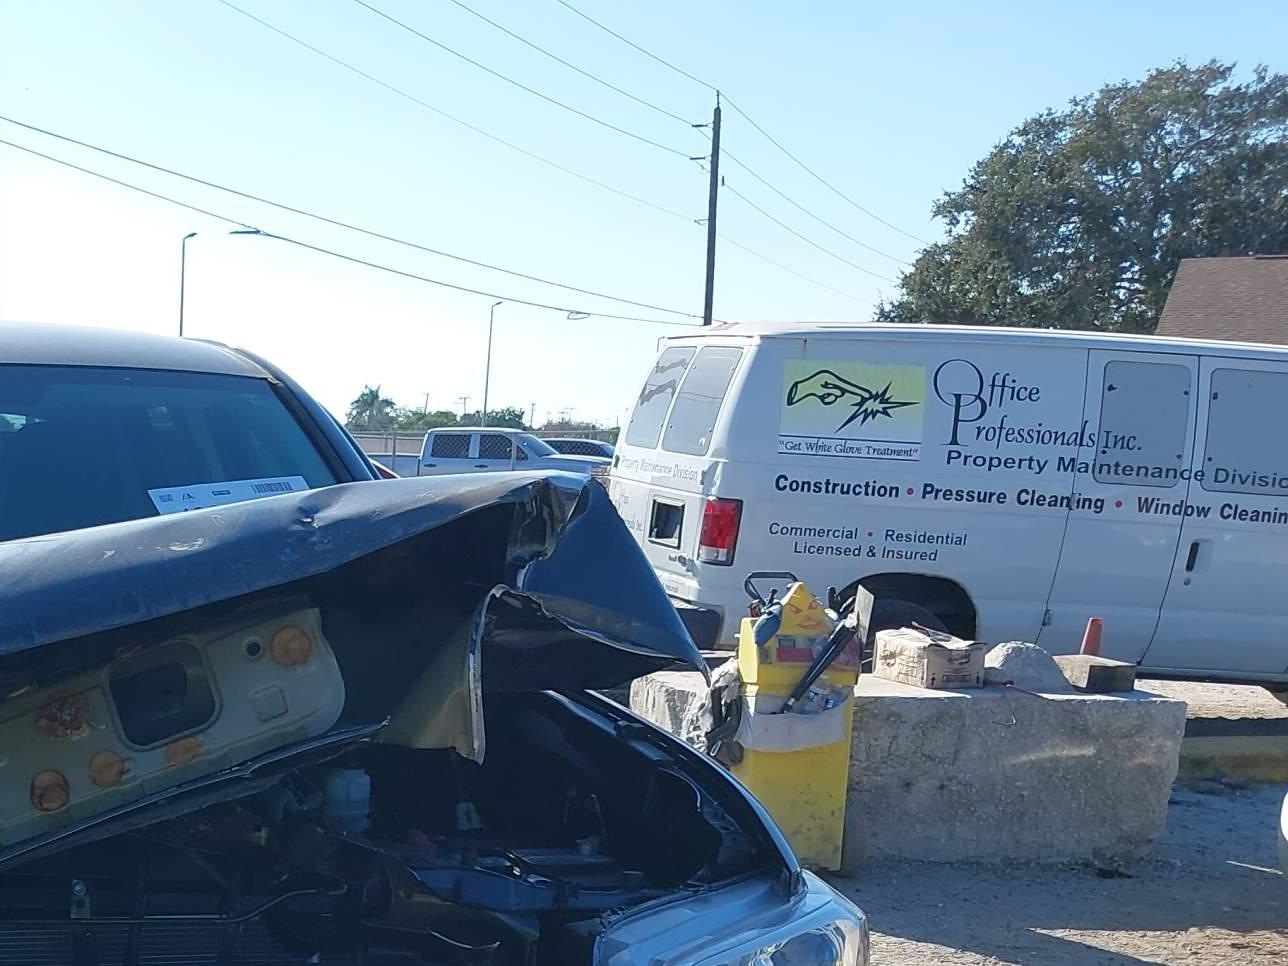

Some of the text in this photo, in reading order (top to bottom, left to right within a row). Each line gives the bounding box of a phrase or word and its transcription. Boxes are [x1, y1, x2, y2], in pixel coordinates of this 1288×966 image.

[933, 359, 1040, 407] Office
[939, 393, 1142, 450] Professionals Inc.
[805, 438, 832, 454] White
[834, 441, 862, 455] Glove
[946, 450, 1048, 473] Property
[1056, 456, 1205, 482] Maintenance
[774, 474, 900, 498] Construction
[922, 483, 1007, 504] Pressure
[1016, 488, 1105, 514] Cleaning
[1137, 496, 1211, 518] Window
[769, 522, 967, 546] Commercial Residential
[793, 541, 938, 561] Licensed & Insured
